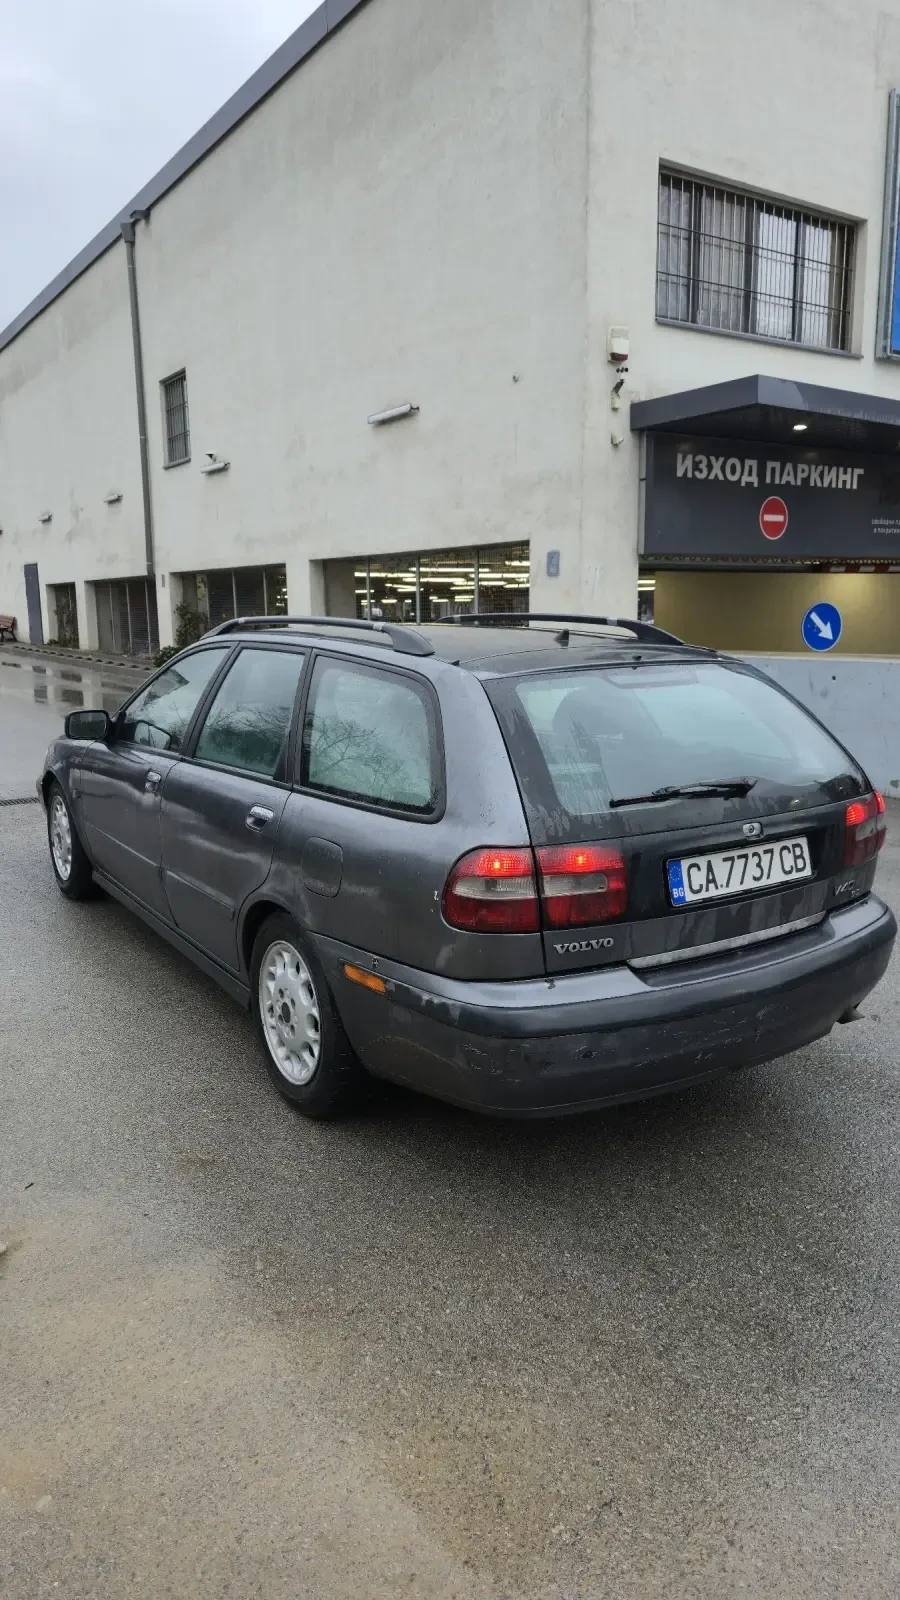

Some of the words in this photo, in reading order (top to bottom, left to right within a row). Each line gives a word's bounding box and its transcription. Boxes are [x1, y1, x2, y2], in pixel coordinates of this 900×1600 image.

[676, 453, 758, 487] ИЗХОД
[766, 461, 864, 490] ПАРКИНГ
[672, 887, 684, 898] BG
[553, 937, 615, 954] VOLVO
